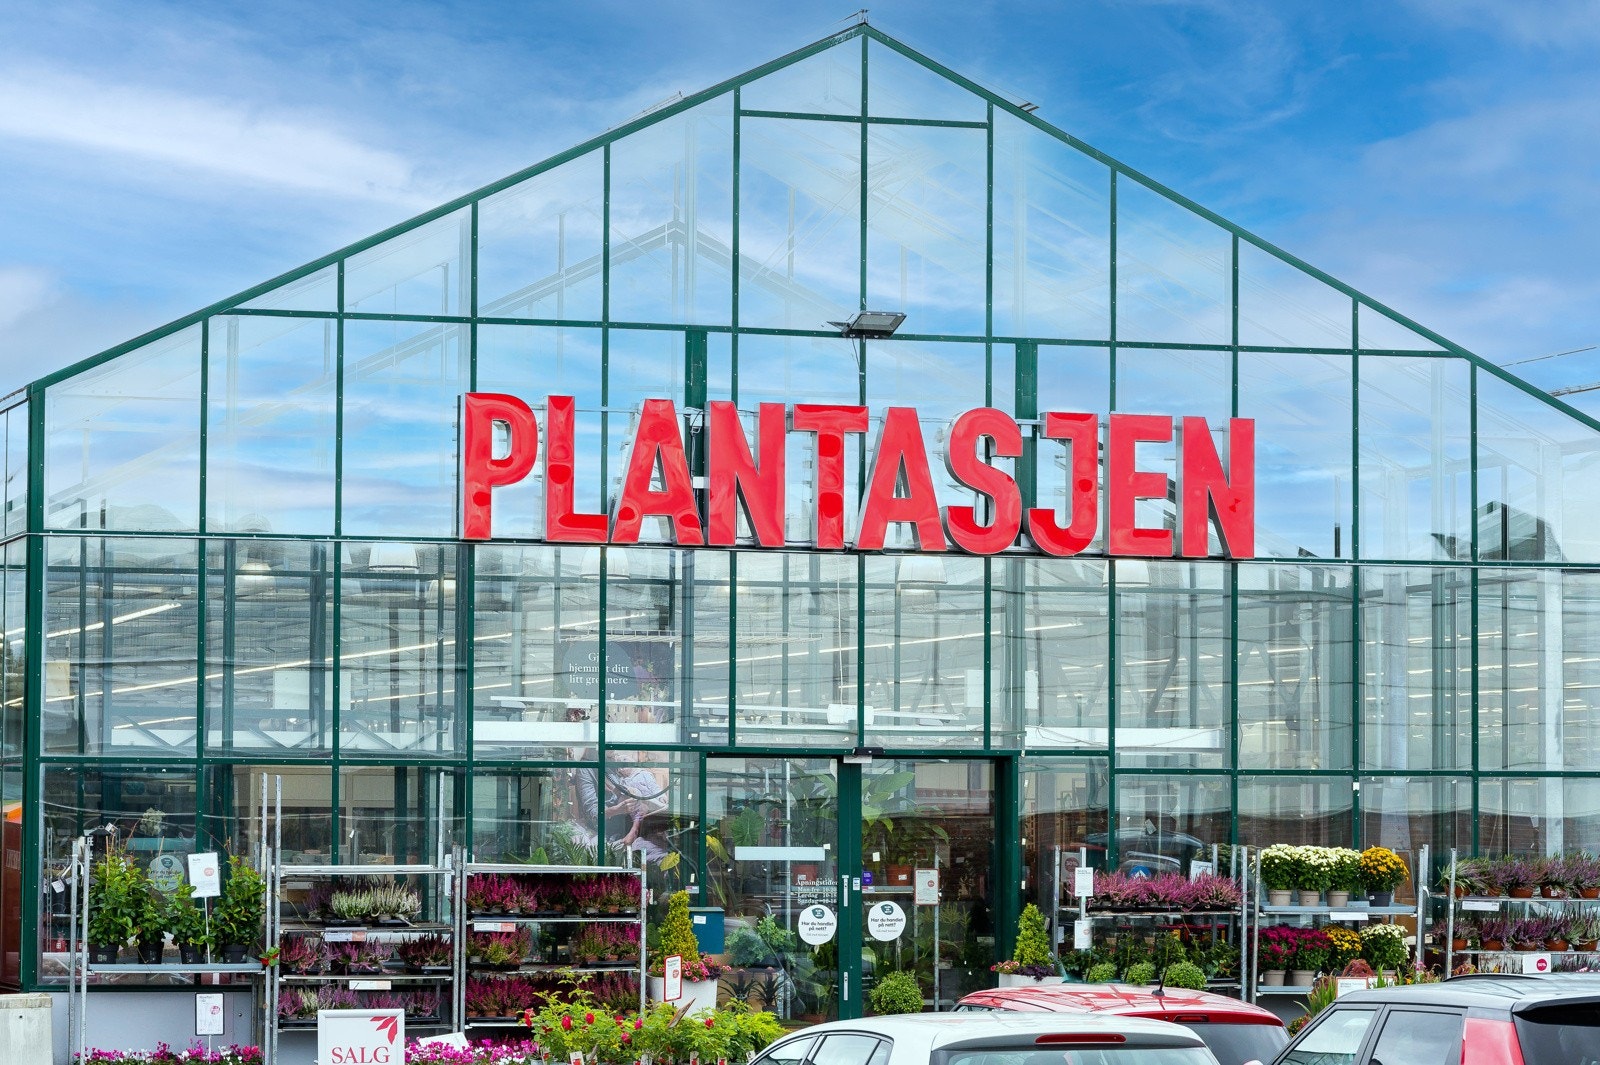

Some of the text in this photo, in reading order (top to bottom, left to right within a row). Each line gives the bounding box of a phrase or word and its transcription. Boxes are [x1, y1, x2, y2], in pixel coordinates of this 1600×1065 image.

[460, 391, 1255, 559] PLANTASJEN
[588, 652, 610, 663] Gjr
[569, 663, 629, 674] hjemmt ditt
[569, 674, 583, 684] litt
[331, 1046, 390, 1064] SALG
